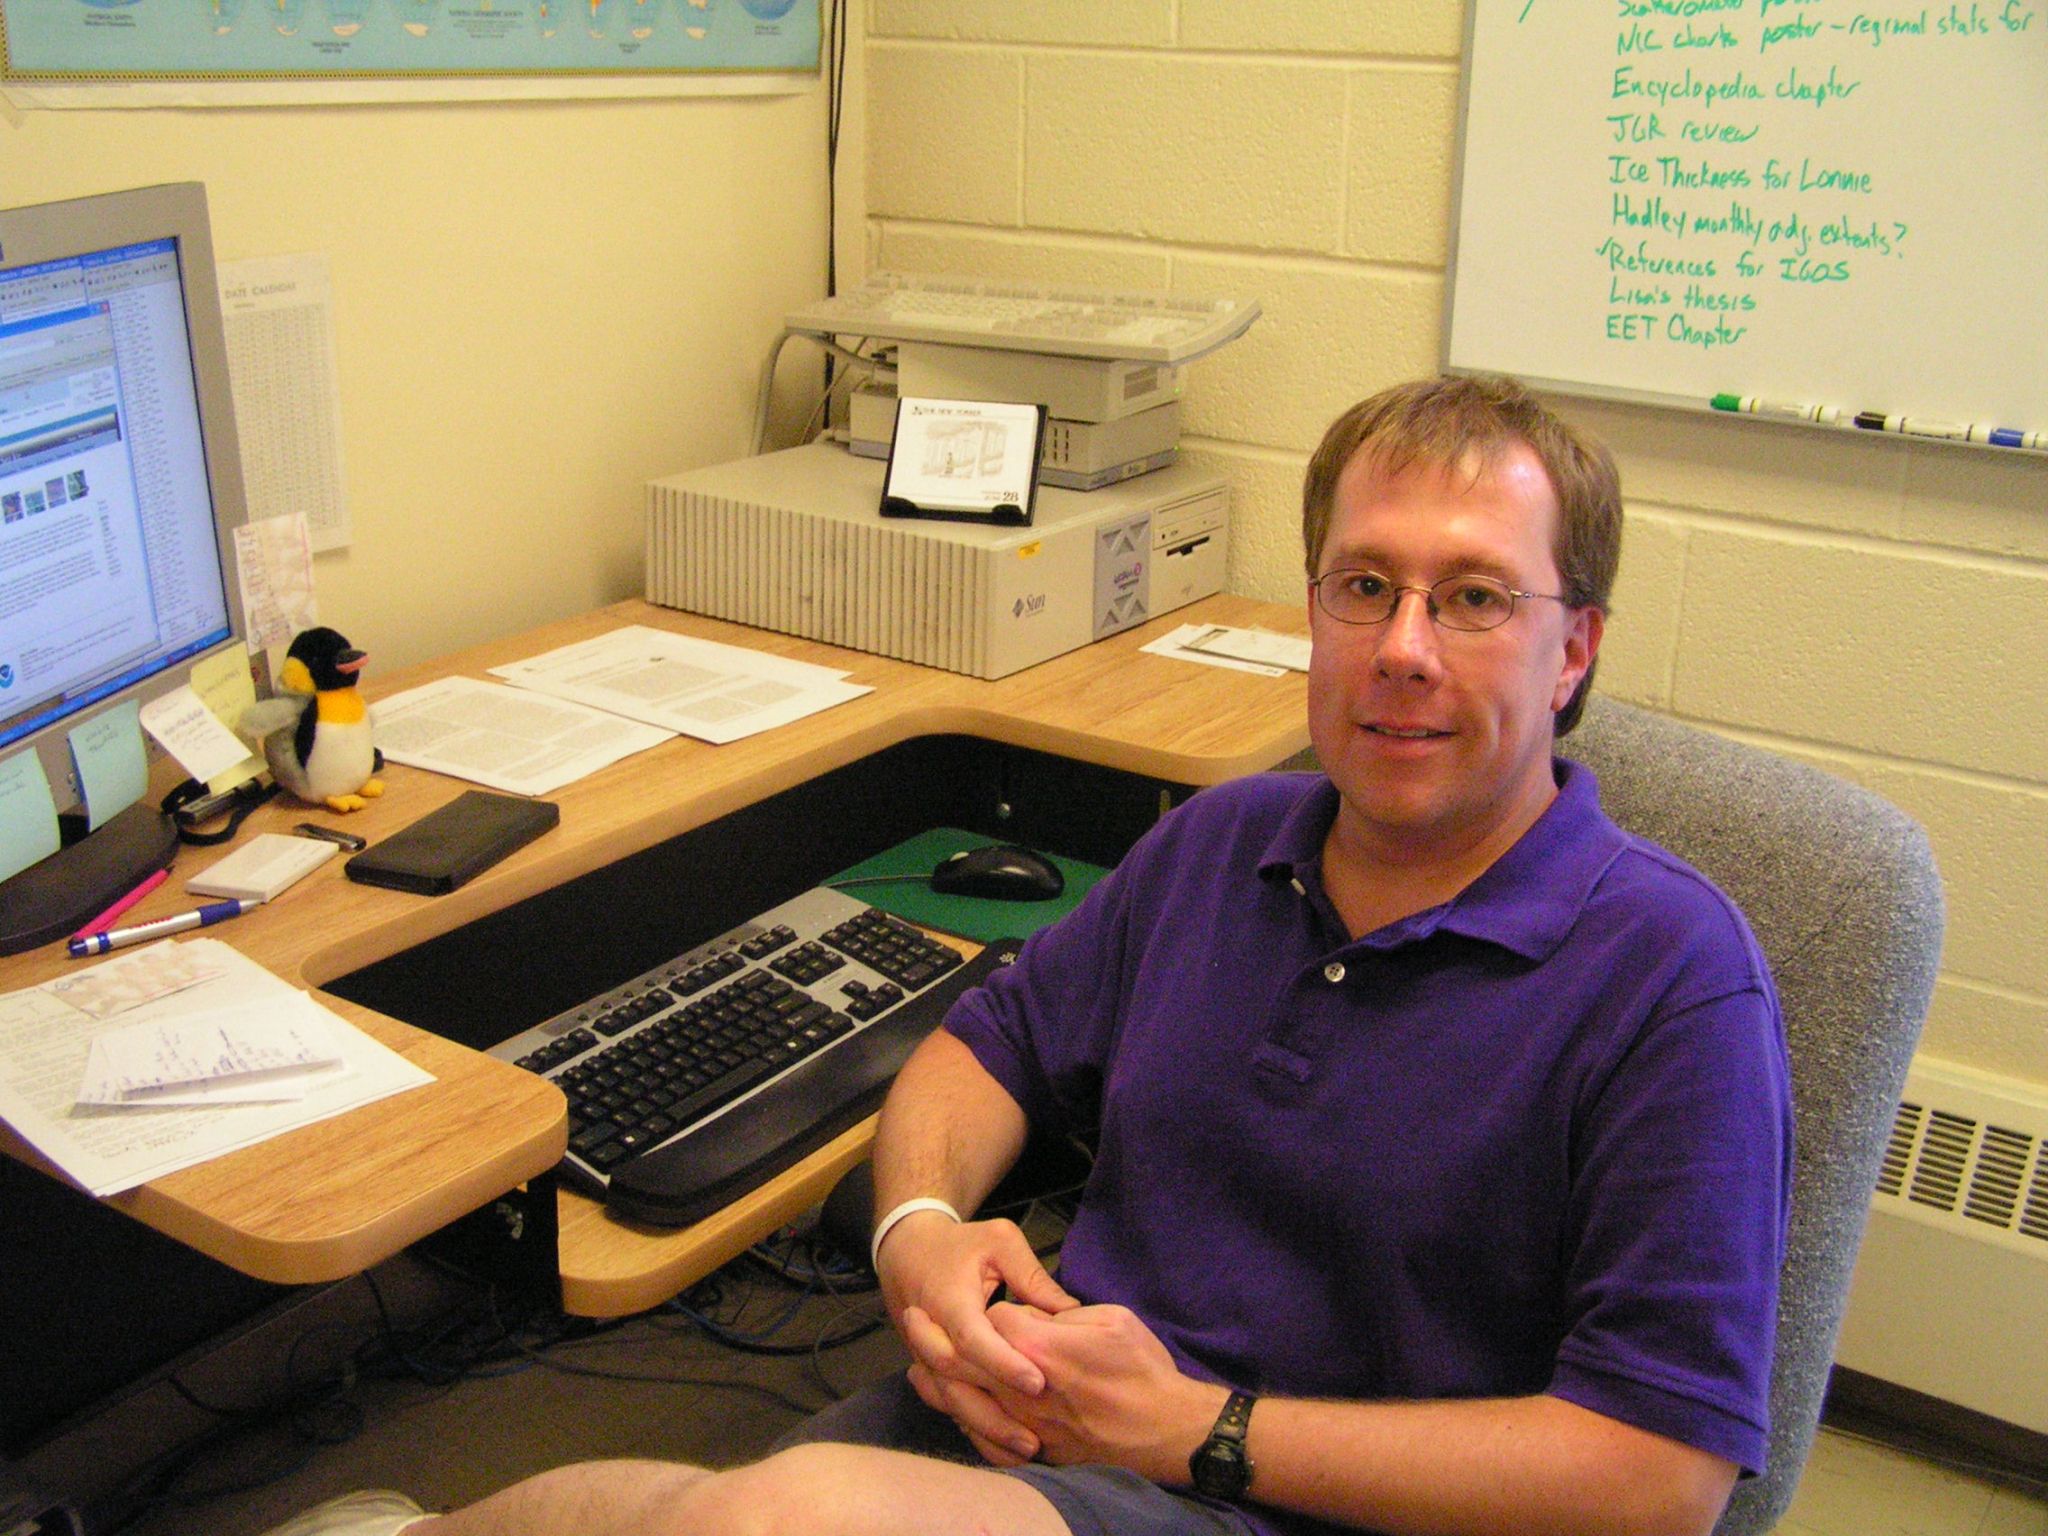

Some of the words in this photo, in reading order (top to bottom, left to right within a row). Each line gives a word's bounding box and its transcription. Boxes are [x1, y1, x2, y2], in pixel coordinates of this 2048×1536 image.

[1617, 22, 1663, 55] NIC
[1759, 12, 1823, 54] poster
[1936, 3, 1990, 36] stats
[1998, 0, 2034, 33] for
[1611, 65, 1766, 108] Encyclopedia
[1775, 64, 1862, 109] chapter
[1605, 112, 1666, 143] JGR
[1680, 120, 1760, 143] review
[1607, 155, 1650, 184] Ice
[1656, 155, 1752, 190] Thickness
[1761, 158, 1792, 191] for
[1799, 157, 1873, 193] Lonnie
[1612, 192, 1686, 239] Hadley
[1693, 201, 1764, 246] monthly
[1608, 240, 1717, 278] References
[1735, 249, 1765, 278] for
[1682, 283, 1757, 311] thesis
[1605, 313, 1660, 340] EET
[1666, 312, 1748, 350] Chapter
